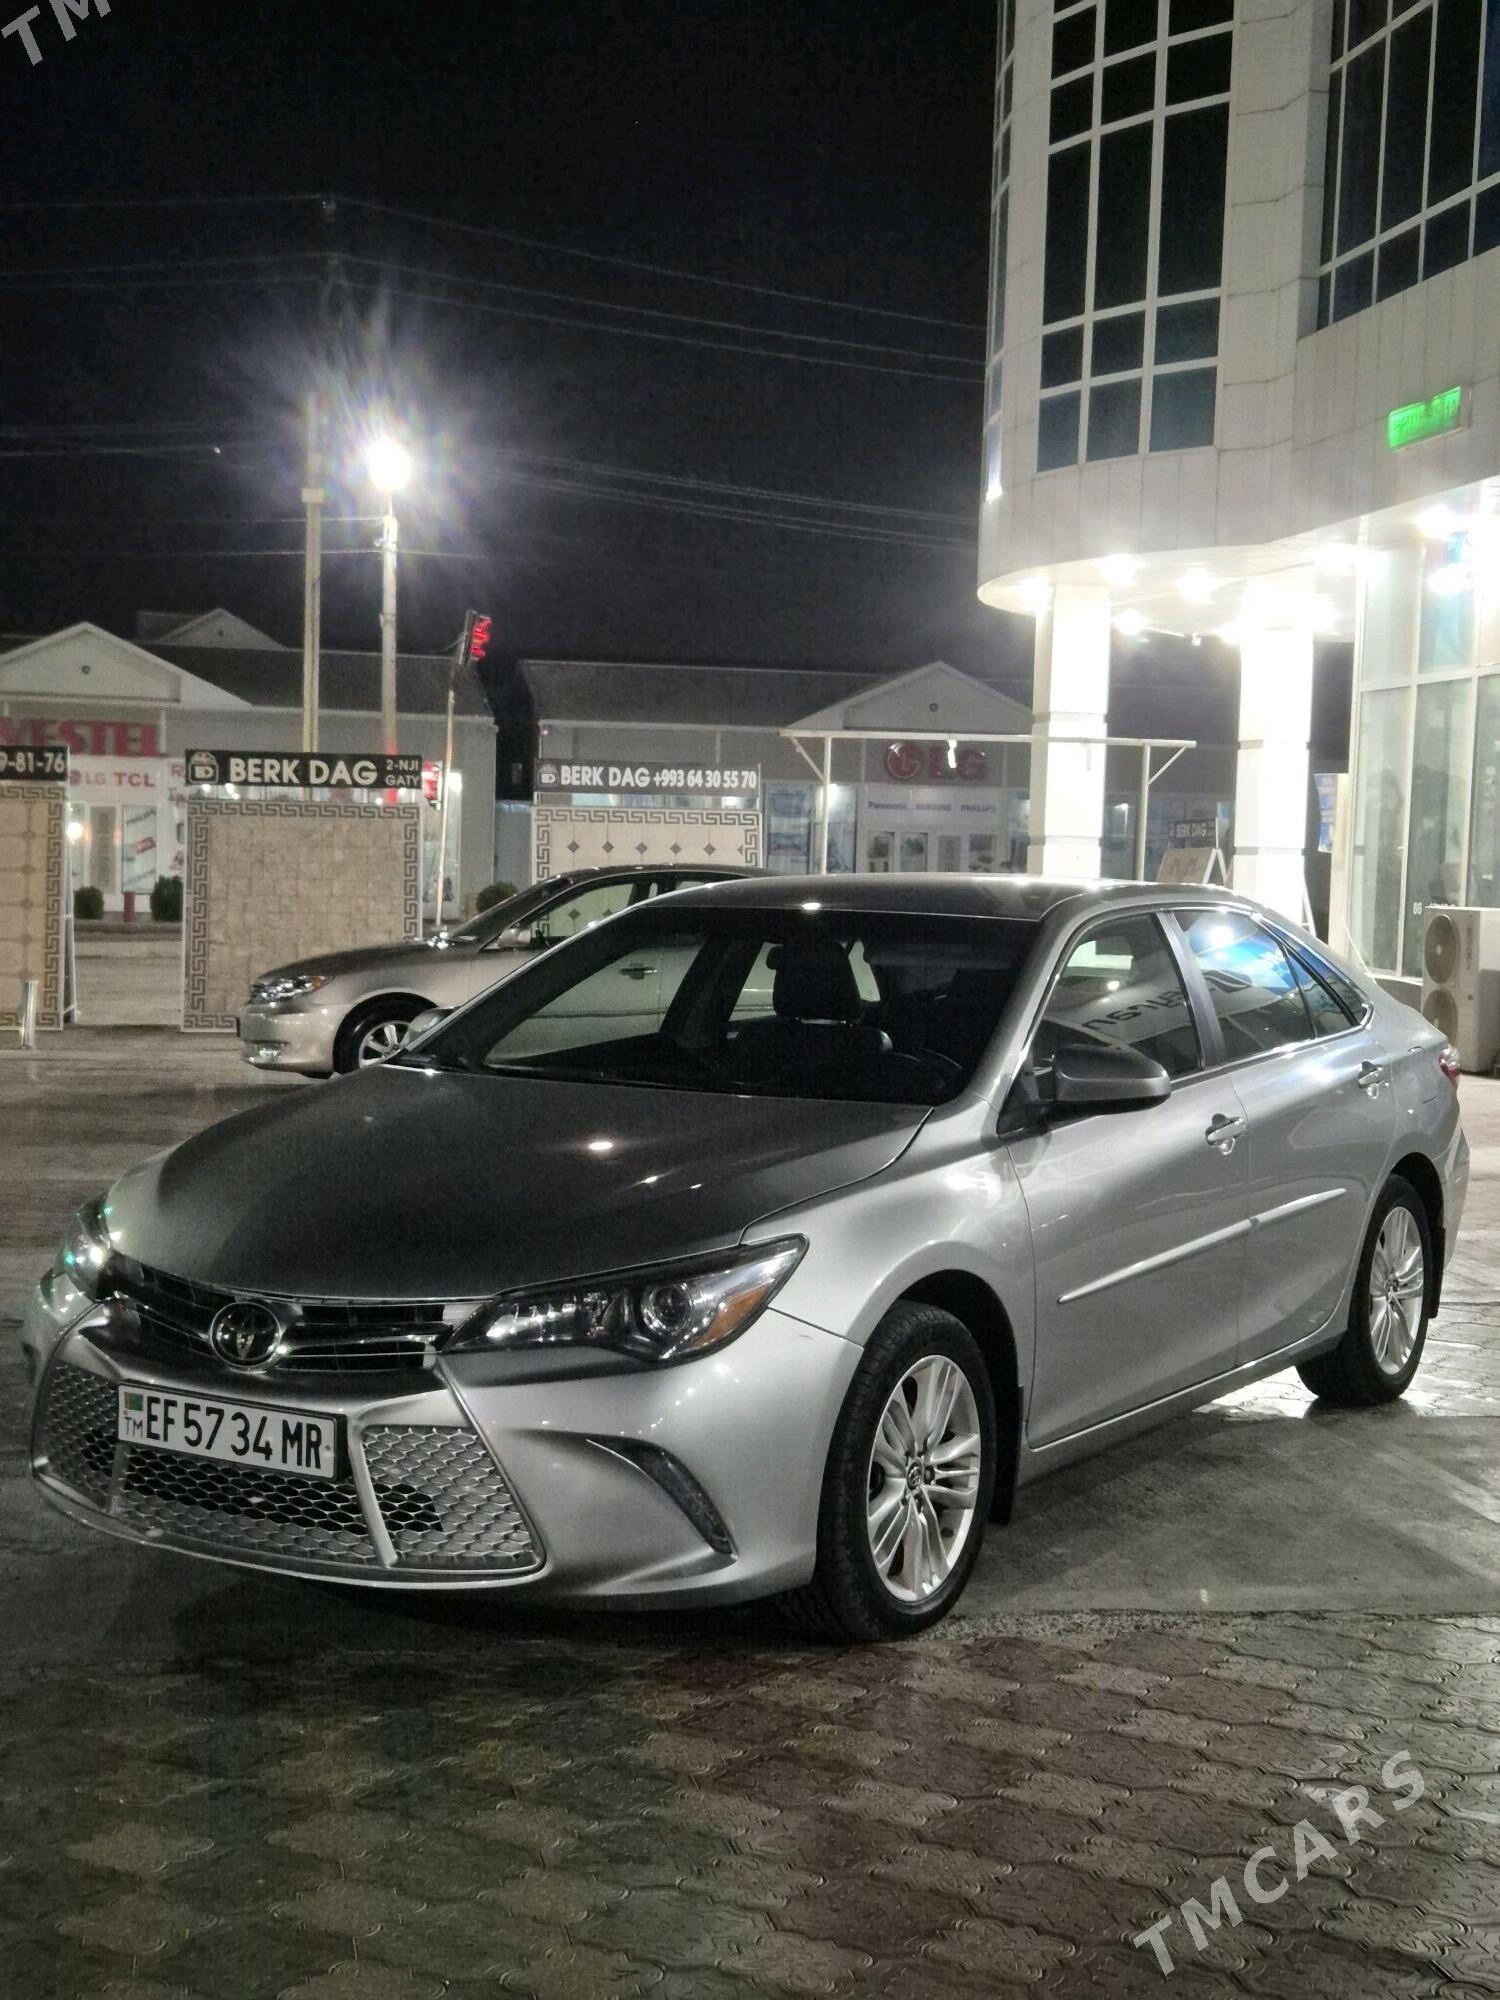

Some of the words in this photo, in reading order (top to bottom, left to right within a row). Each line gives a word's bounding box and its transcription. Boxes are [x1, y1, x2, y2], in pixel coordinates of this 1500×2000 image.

[229, 757, 300, 784] BERK
[308, 759, 378, 786] DAG
[385, 759, 419, 771] 2-NJI
[114, 772, 155, 787] TCL
[385, 774, 419, 787] GATY
[560, 765, 604, 786] BERK
[608, 766, 650, 787] DAG
[653, 768, 684, 788] +993
[687, 769, 702, 788] 64
[705, 770, 720, 788] 30
[723, 770, 739, 789] 55
[741, 770, 757, 789] 70
[124, 1416, 144, 1438] TM
